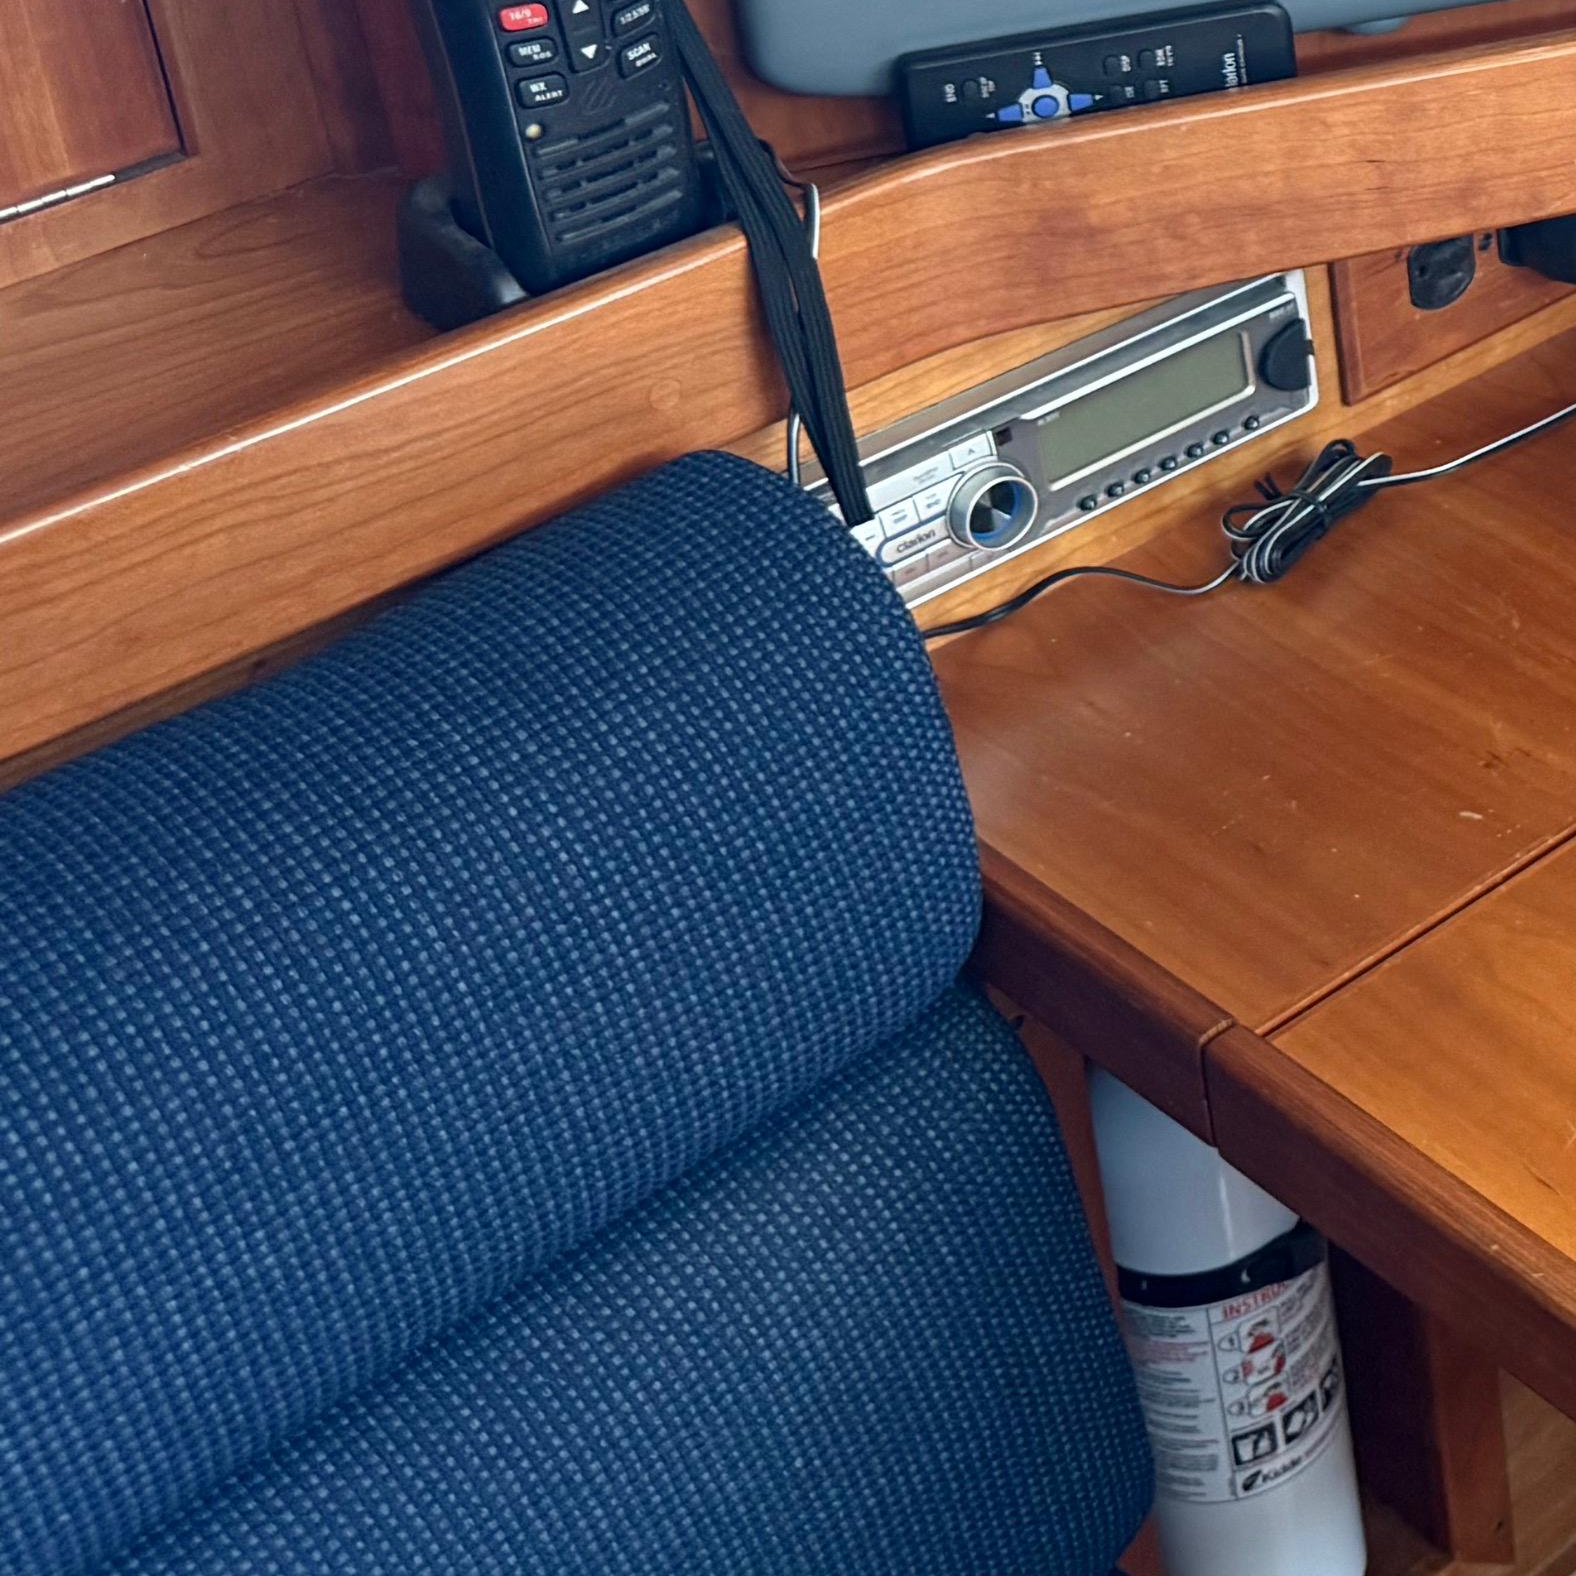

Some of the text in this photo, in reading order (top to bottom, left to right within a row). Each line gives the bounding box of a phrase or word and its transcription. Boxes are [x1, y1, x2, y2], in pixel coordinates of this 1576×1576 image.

[627, 43, 651, 61] SCAN
[534, 90, 563, 102] ALERT
[896, 529, 936, 553] clarion
